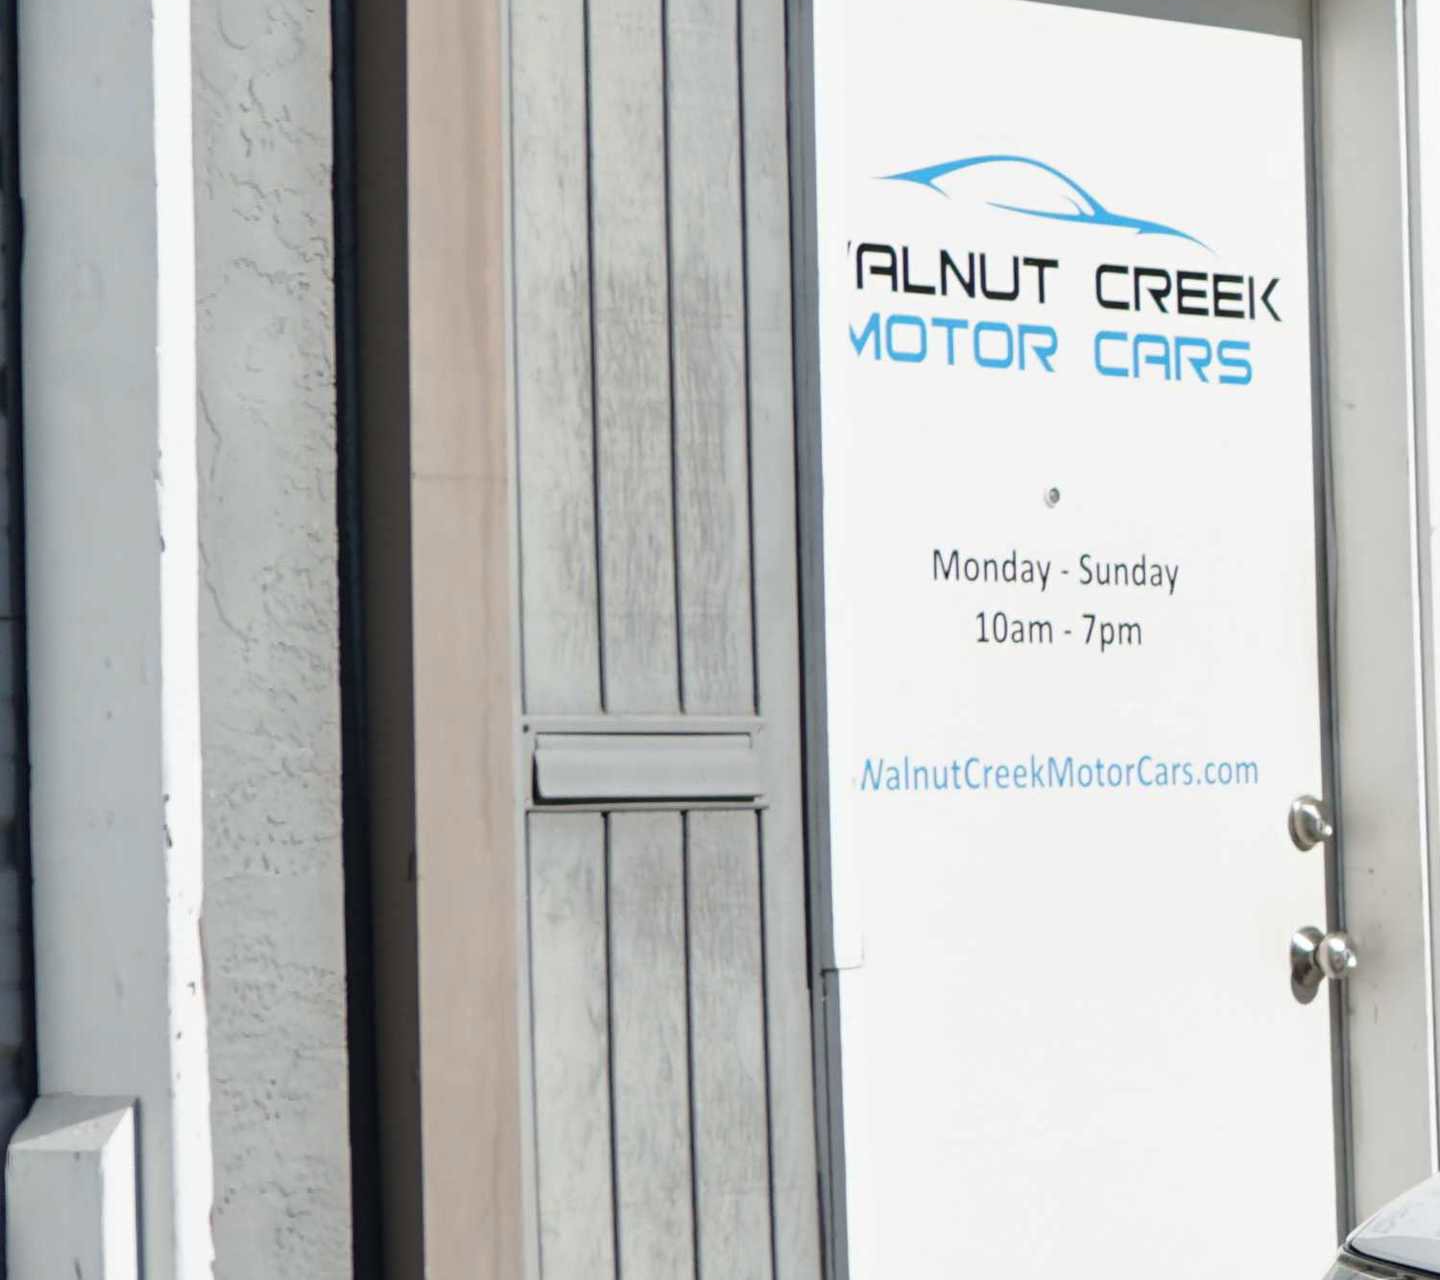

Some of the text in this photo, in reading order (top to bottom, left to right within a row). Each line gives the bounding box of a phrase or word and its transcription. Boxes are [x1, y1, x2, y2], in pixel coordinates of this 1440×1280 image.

[847, 240, 1283, 323] ALNUT CREEK
[847, 310, 1255, 387] MOTOR CARS
[931, 547, 1053, 593] Monday
[1078, 552, 1180, 596] Sunday
[974, 610, 1055, 645] 10am
[1080, 613, 1143, 654] 7pm
